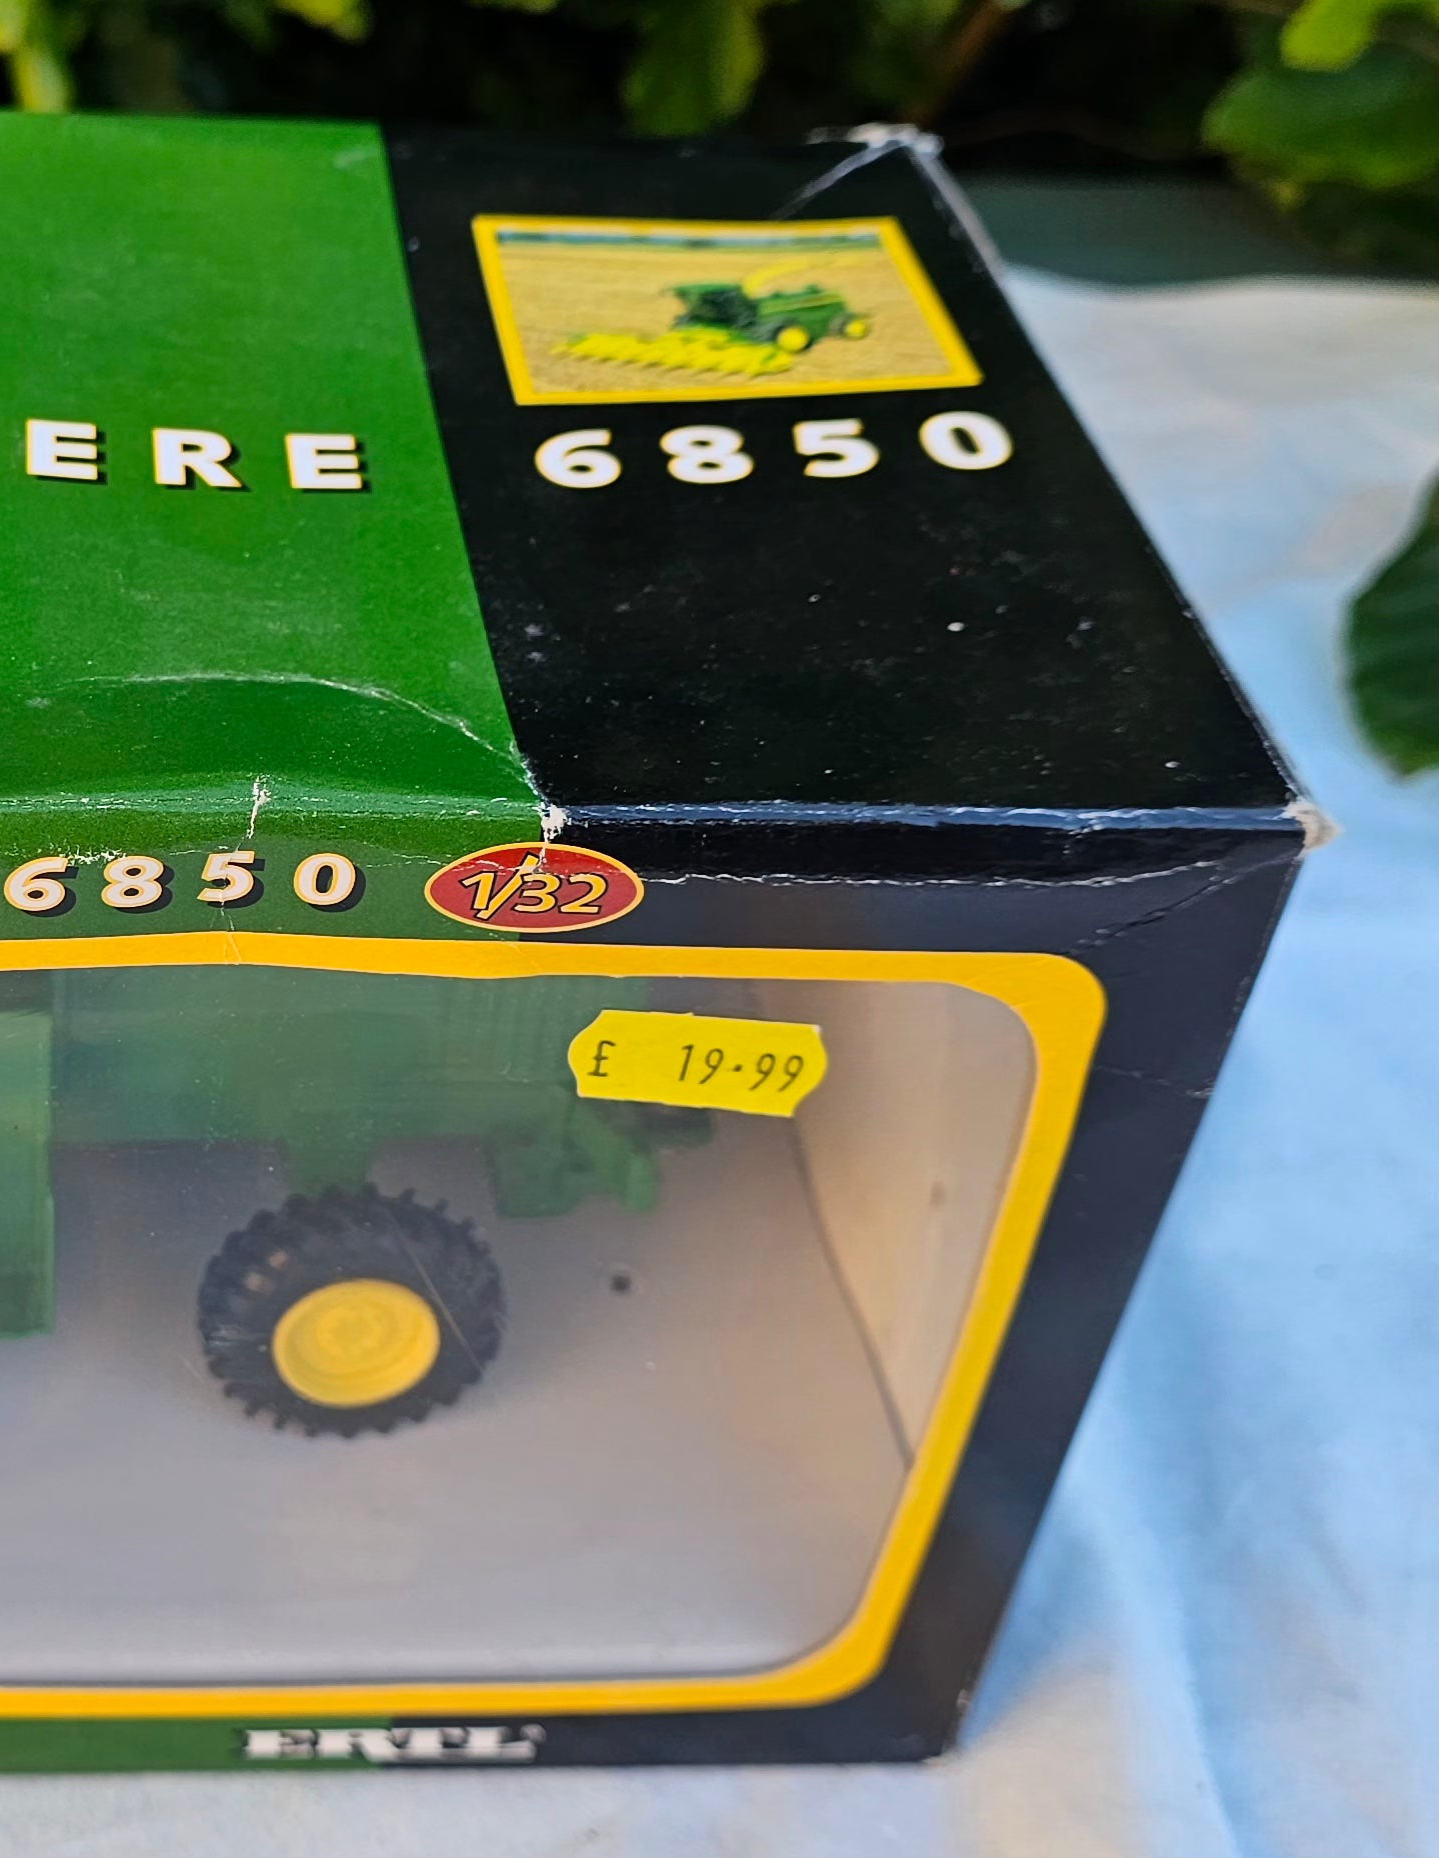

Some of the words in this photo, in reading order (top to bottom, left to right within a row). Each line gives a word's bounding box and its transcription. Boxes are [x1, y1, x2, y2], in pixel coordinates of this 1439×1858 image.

[534, 410, 1014, 489] 6850
[3, 850, 359, 914] 6850
[459, 853, 609, 922] 1/32
[243, 1724, 539, 1763] ERTL
